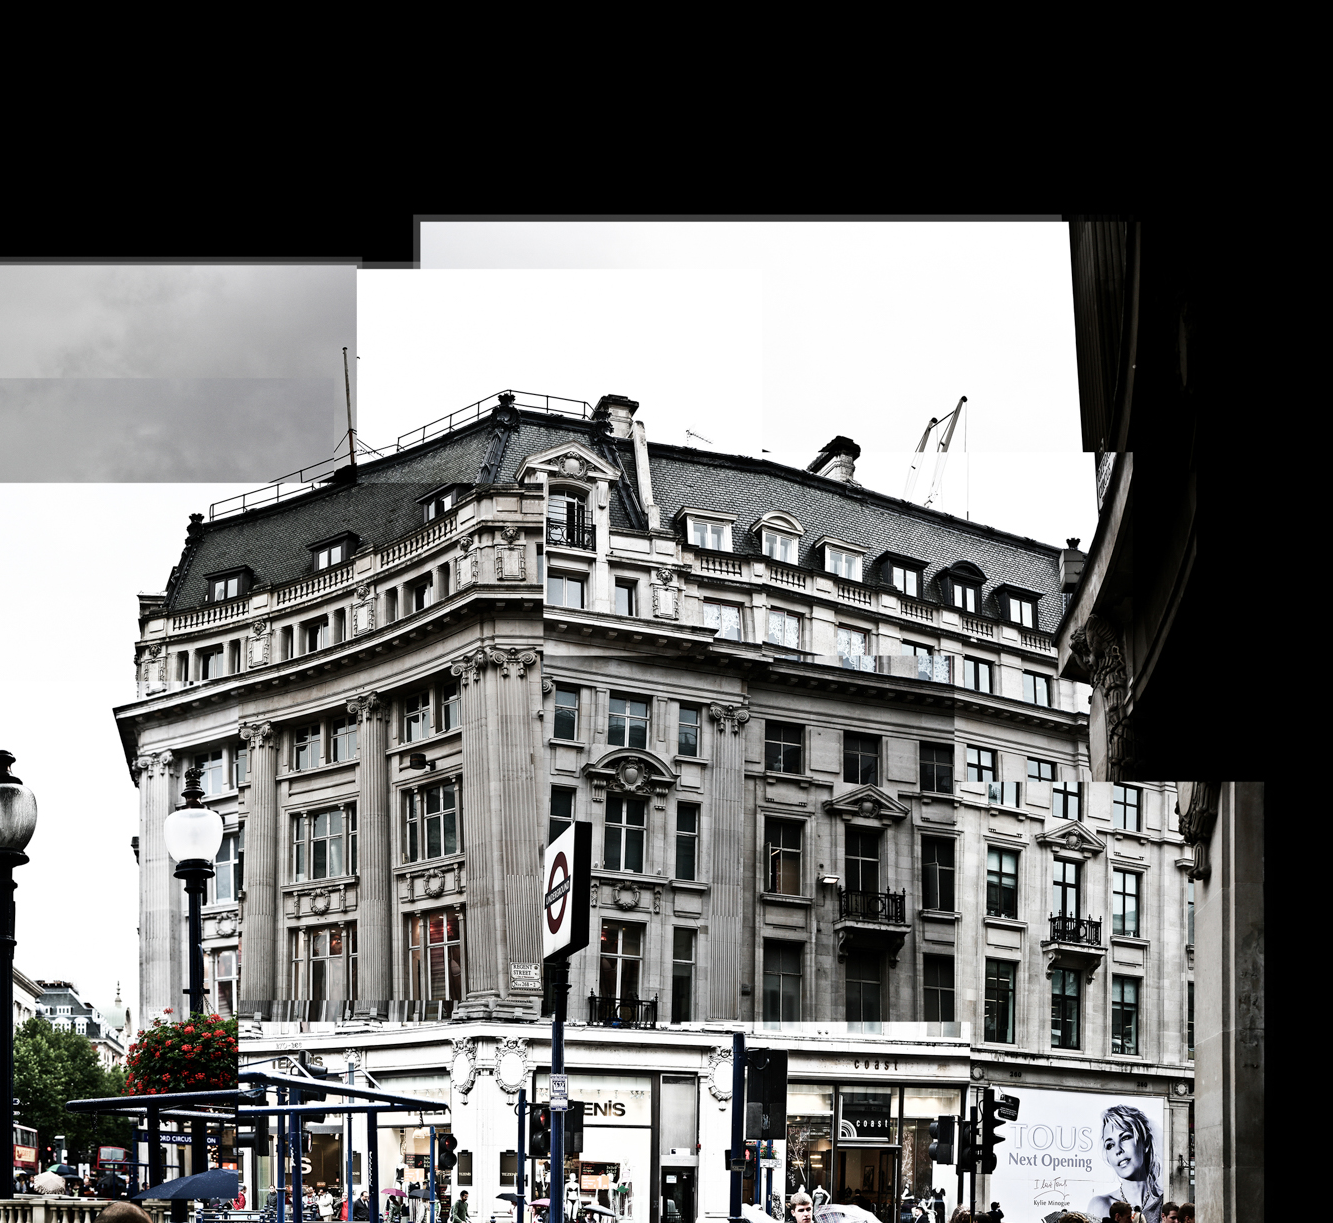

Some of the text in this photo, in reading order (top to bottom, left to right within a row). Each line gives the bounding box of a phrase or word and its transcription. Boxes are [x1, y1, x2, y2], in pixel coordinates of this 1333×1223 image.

[545, 879, 570, 905] UNDERGROUND
[854, 1058, 899, 1071] coast
[855, 1118, 889, 1128] coast
[1009, 1123, 1094, 1153] TOUS
[1008, 1152, 1093, 1173] Next Opening
[1033, 1199, 1047, 1207] Kylie
